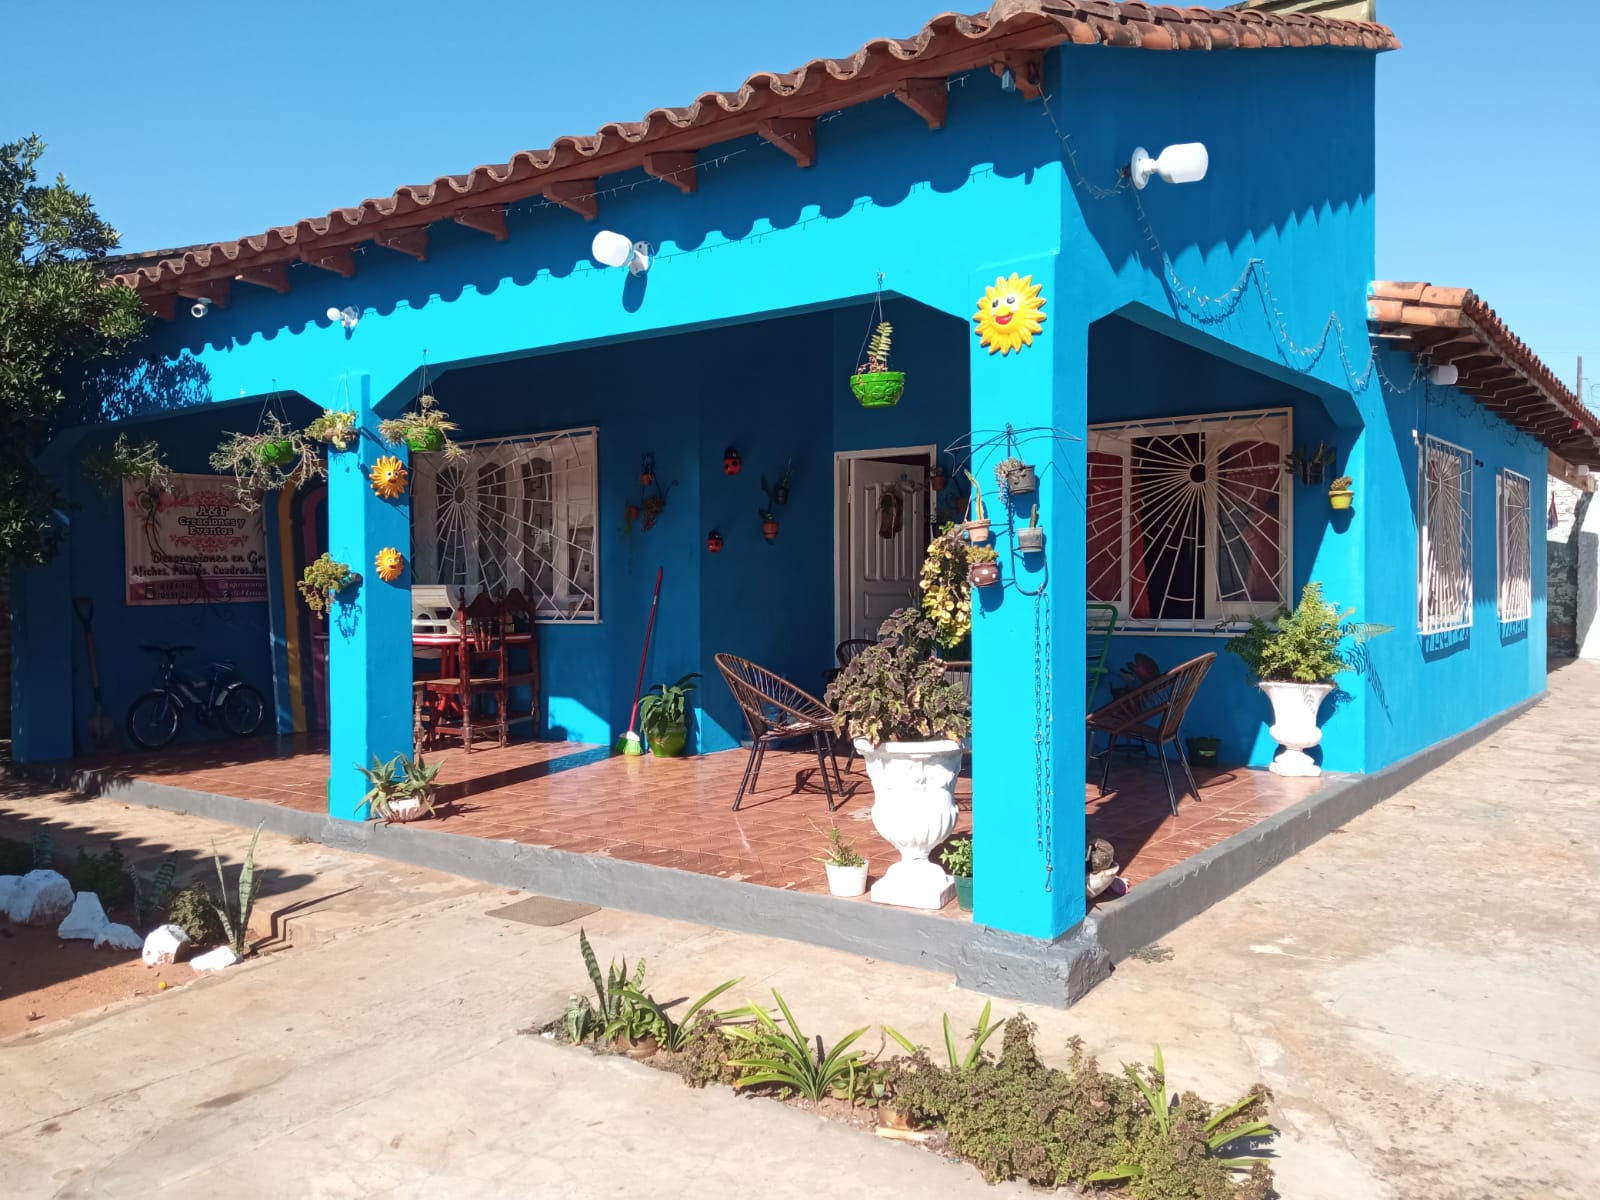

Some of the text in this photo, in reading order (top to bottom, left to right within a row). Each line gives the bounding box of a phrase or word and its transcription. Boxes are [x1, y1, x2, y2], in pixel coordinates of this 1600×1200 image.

[197, 504, 229, 517] A&F
[178, 516, 236, 526] Creaciones
[189, 525, 234, 536] Eventos
